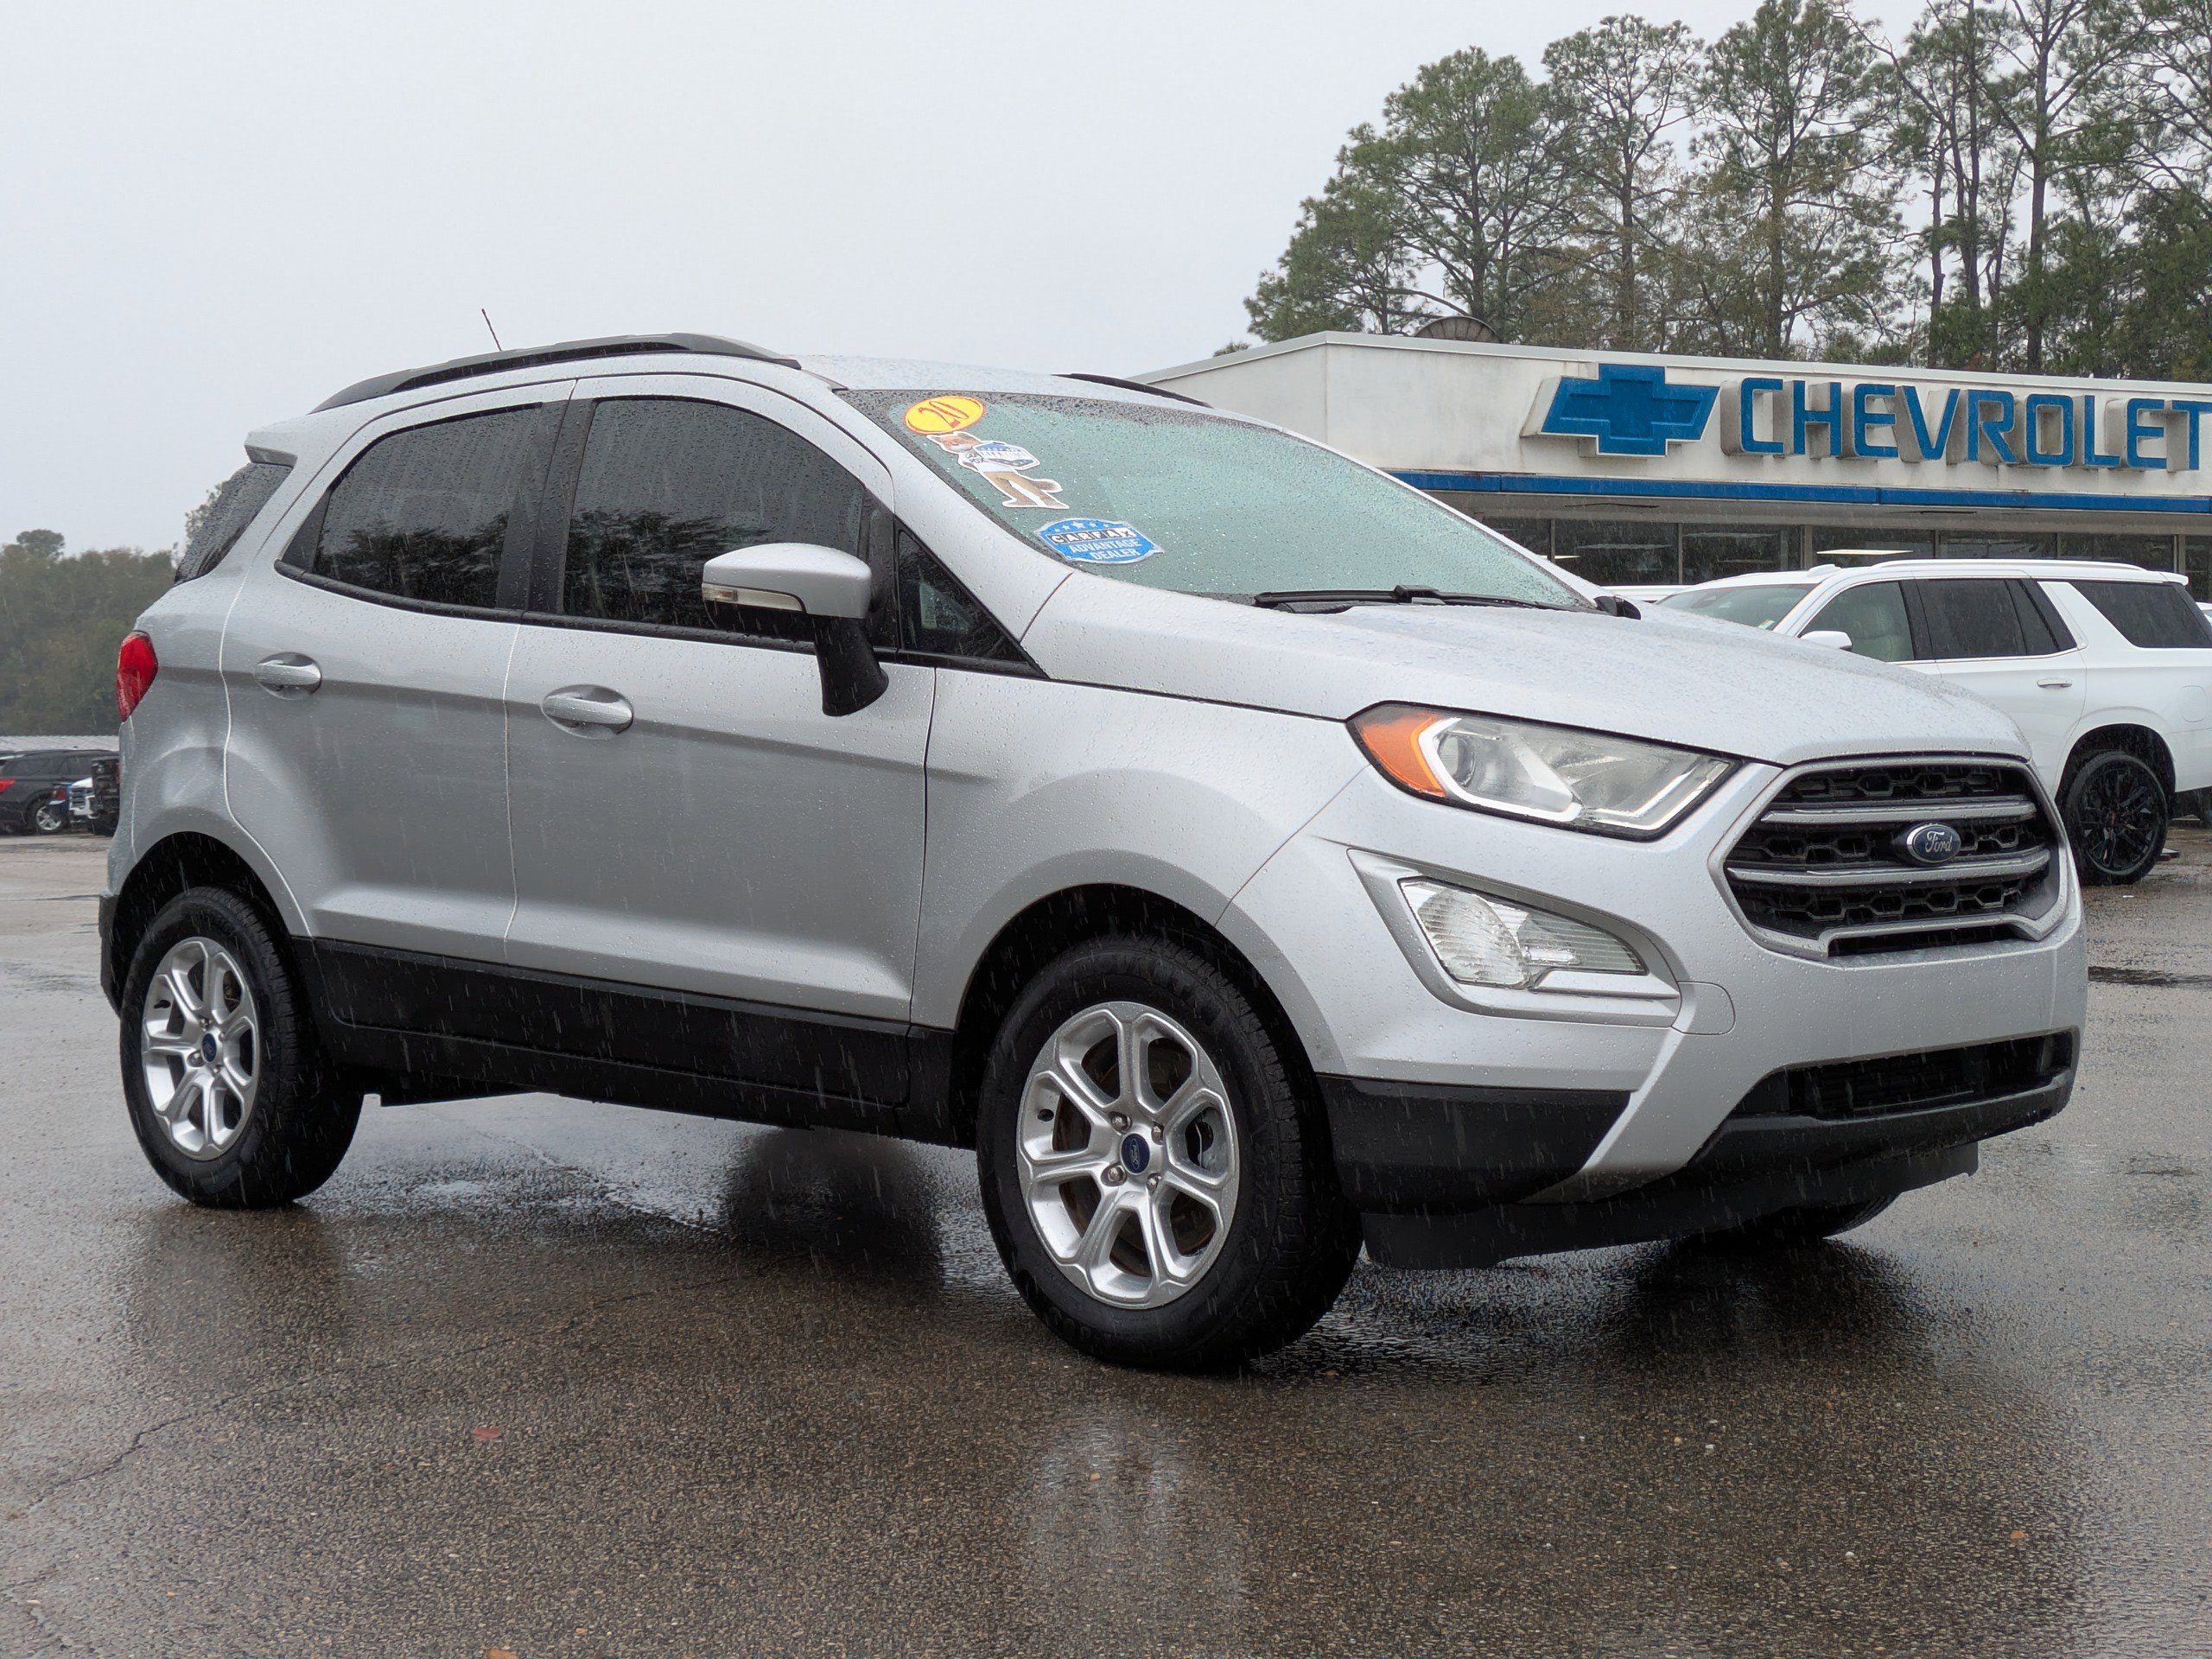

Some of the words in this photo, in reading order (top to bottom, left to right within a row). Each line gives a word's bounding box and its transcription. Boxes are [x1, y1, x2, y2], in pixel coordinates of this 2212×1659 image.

[918, 401, 969, 428] 20
[1740, 378, 2212, 470] CHEVROLET
[1051, 528, 1135, 543] CARFAX
[1069, 538, 1142, 553] ADVANTAGE
[1090, 548, 1141, 560] DEALER
[1925, 830, 1953, 853] Ford
